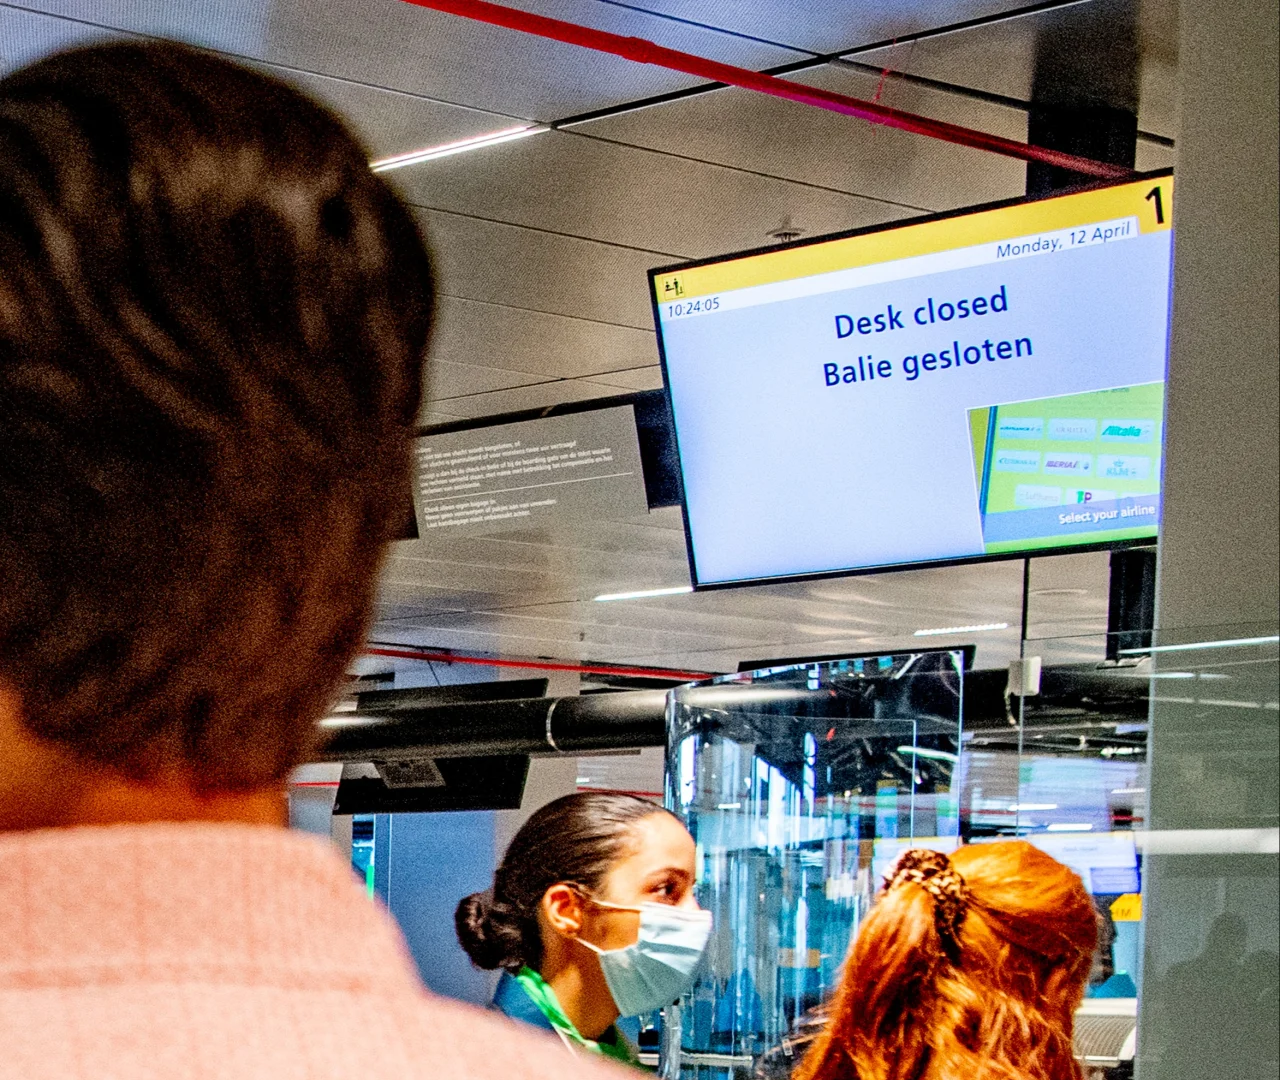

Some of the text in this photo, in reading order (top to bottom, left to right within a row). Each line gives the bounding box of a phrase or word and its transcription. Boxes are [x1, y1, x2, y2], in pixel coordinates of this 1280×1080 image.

[1145, 186, 1164, 224] 1
[996, 221, 1130, 258] Monday, 12 April
[668, 297, 720, 317] 10:24:05
[835, 285, 1008, 339] Desk closed
[823, 337, 1033, 386] Balie gesloten
[1058, 505, 1156, 525] Select your airline
